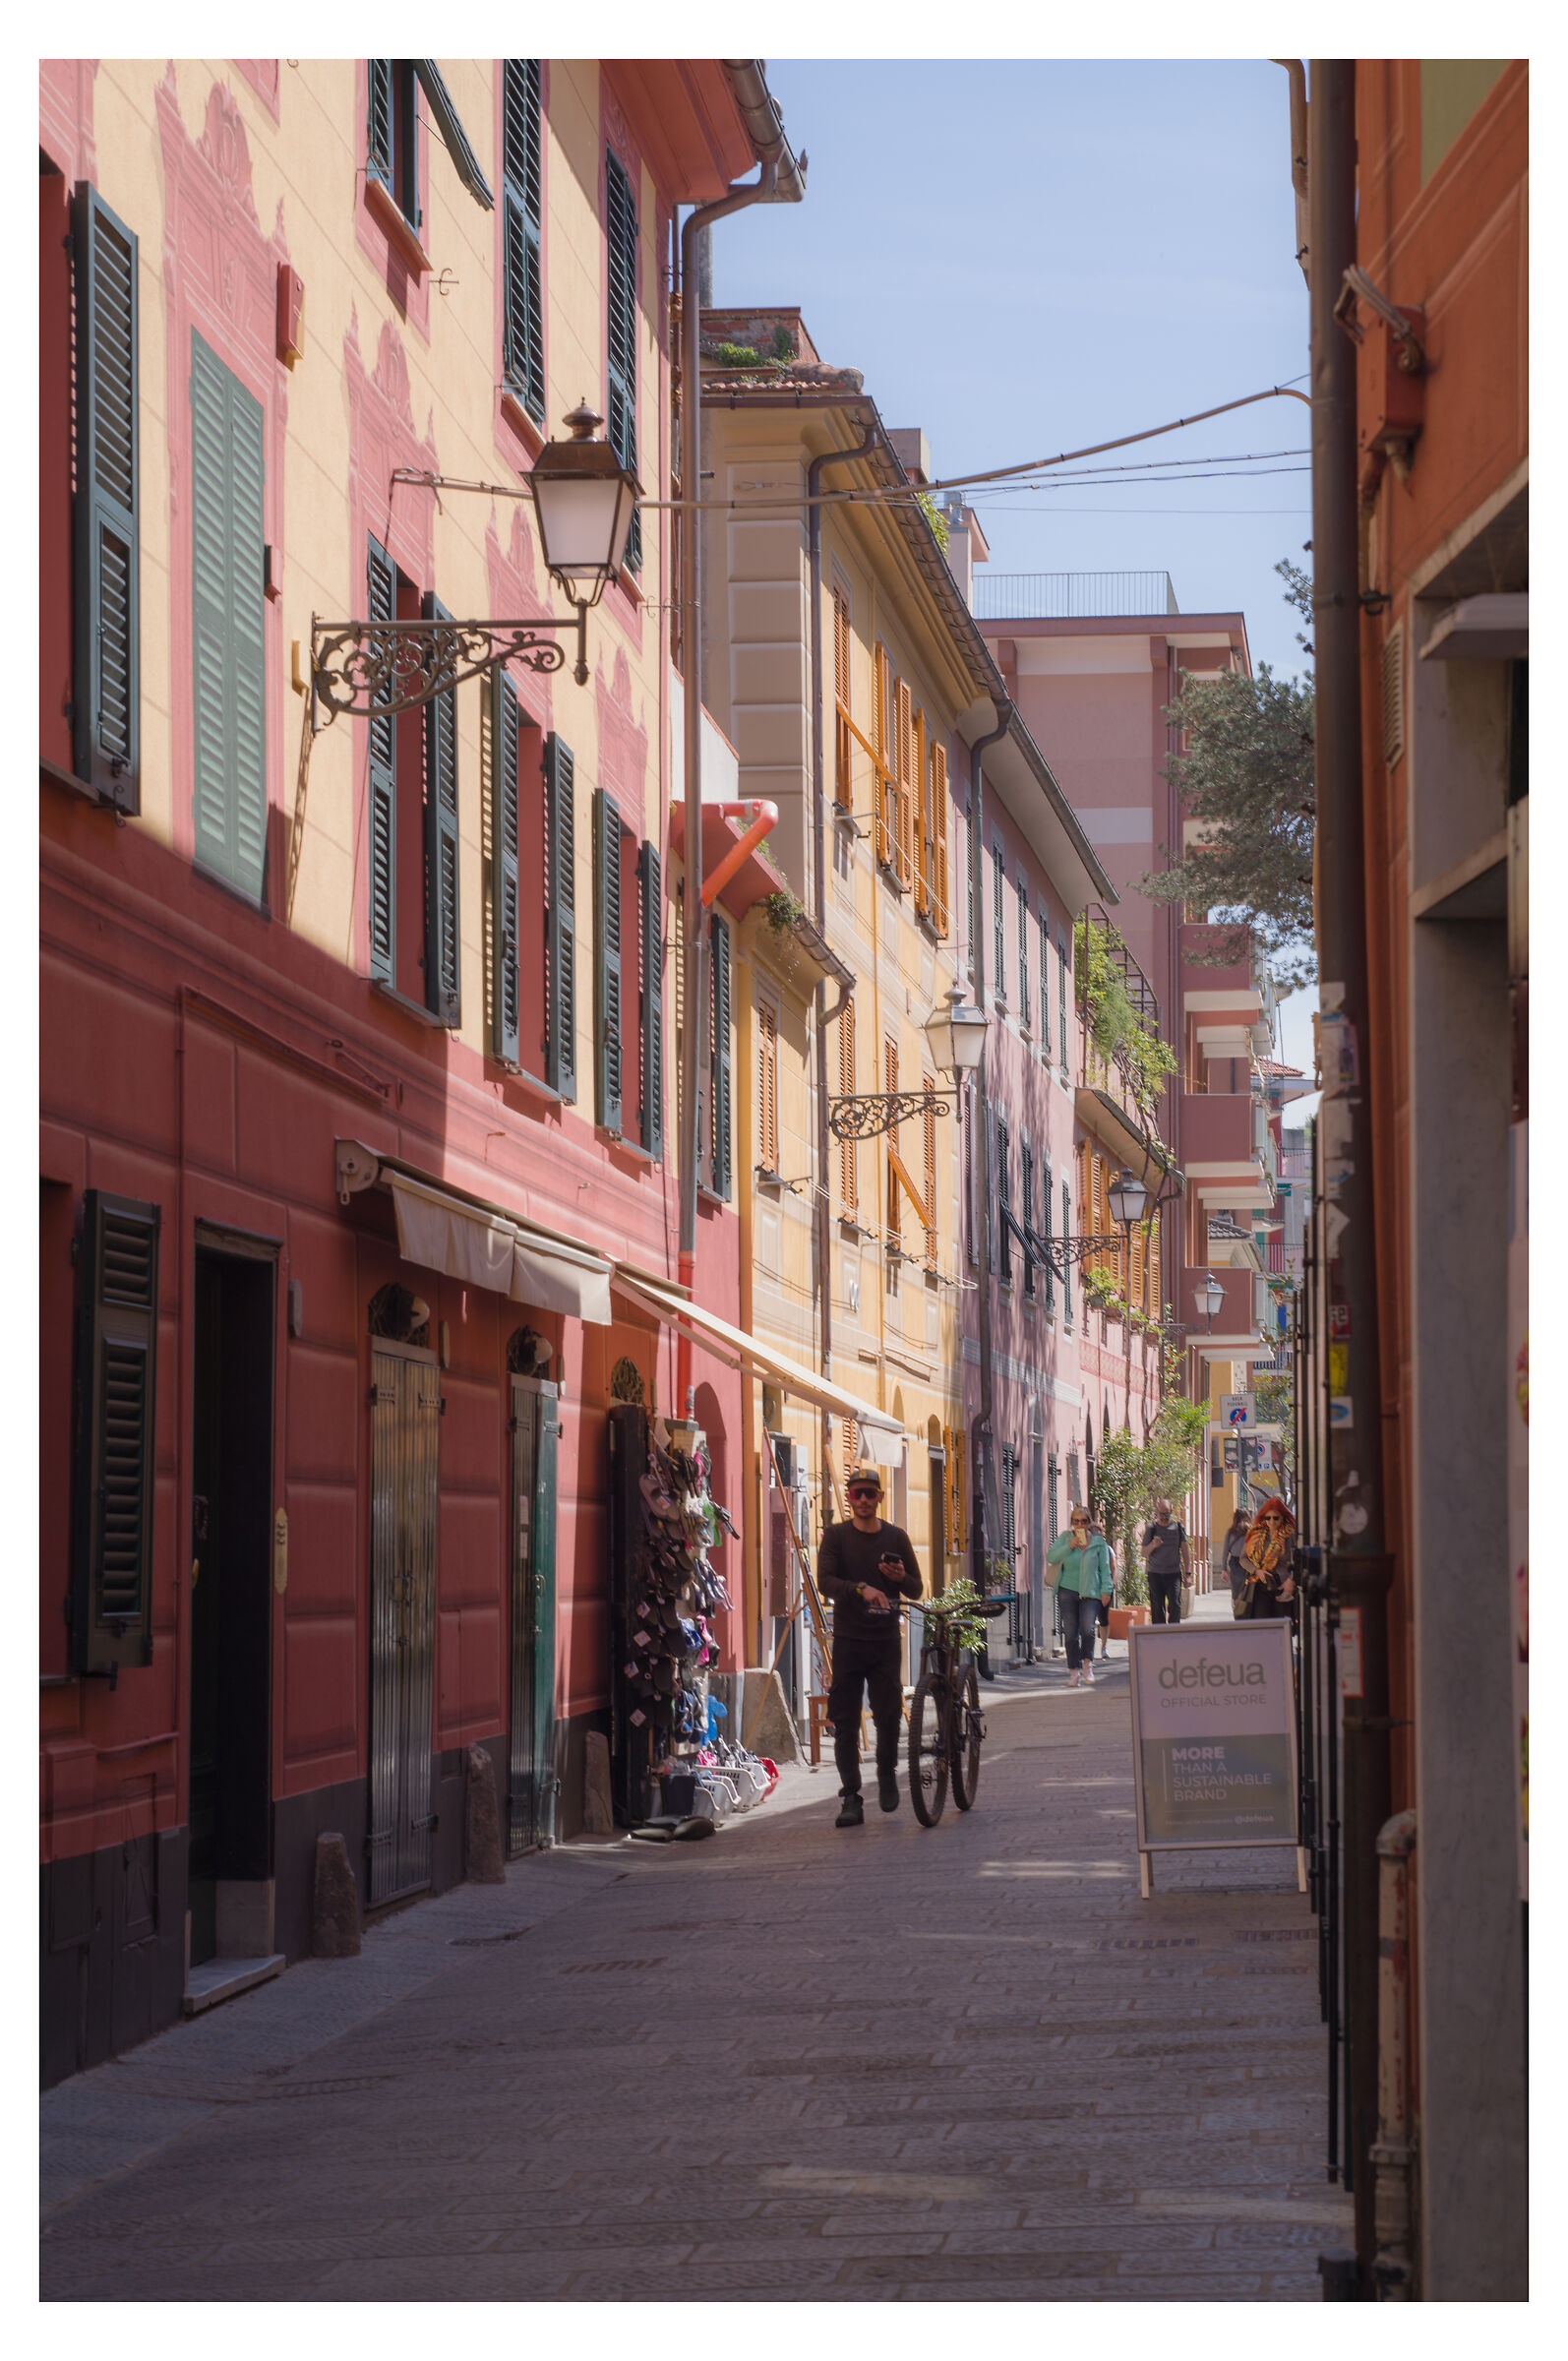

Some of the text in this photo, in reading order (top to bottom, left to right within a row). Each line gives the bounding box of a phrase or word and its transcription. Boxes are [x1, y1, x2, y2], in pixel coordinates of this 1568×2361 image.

[1158, 1657, 1267, 1689] defeua
[1161, 1693, 1267, 1709] OFFICIAL STORE
[1172, 1746, 1225, 1761] MORE
[1173, 1761, 1228, 1774] THAN A
[1173, 1773, 1272, 1788] SUSTAINABLE
[1174, 1788, 1228, 1802] BRAND
